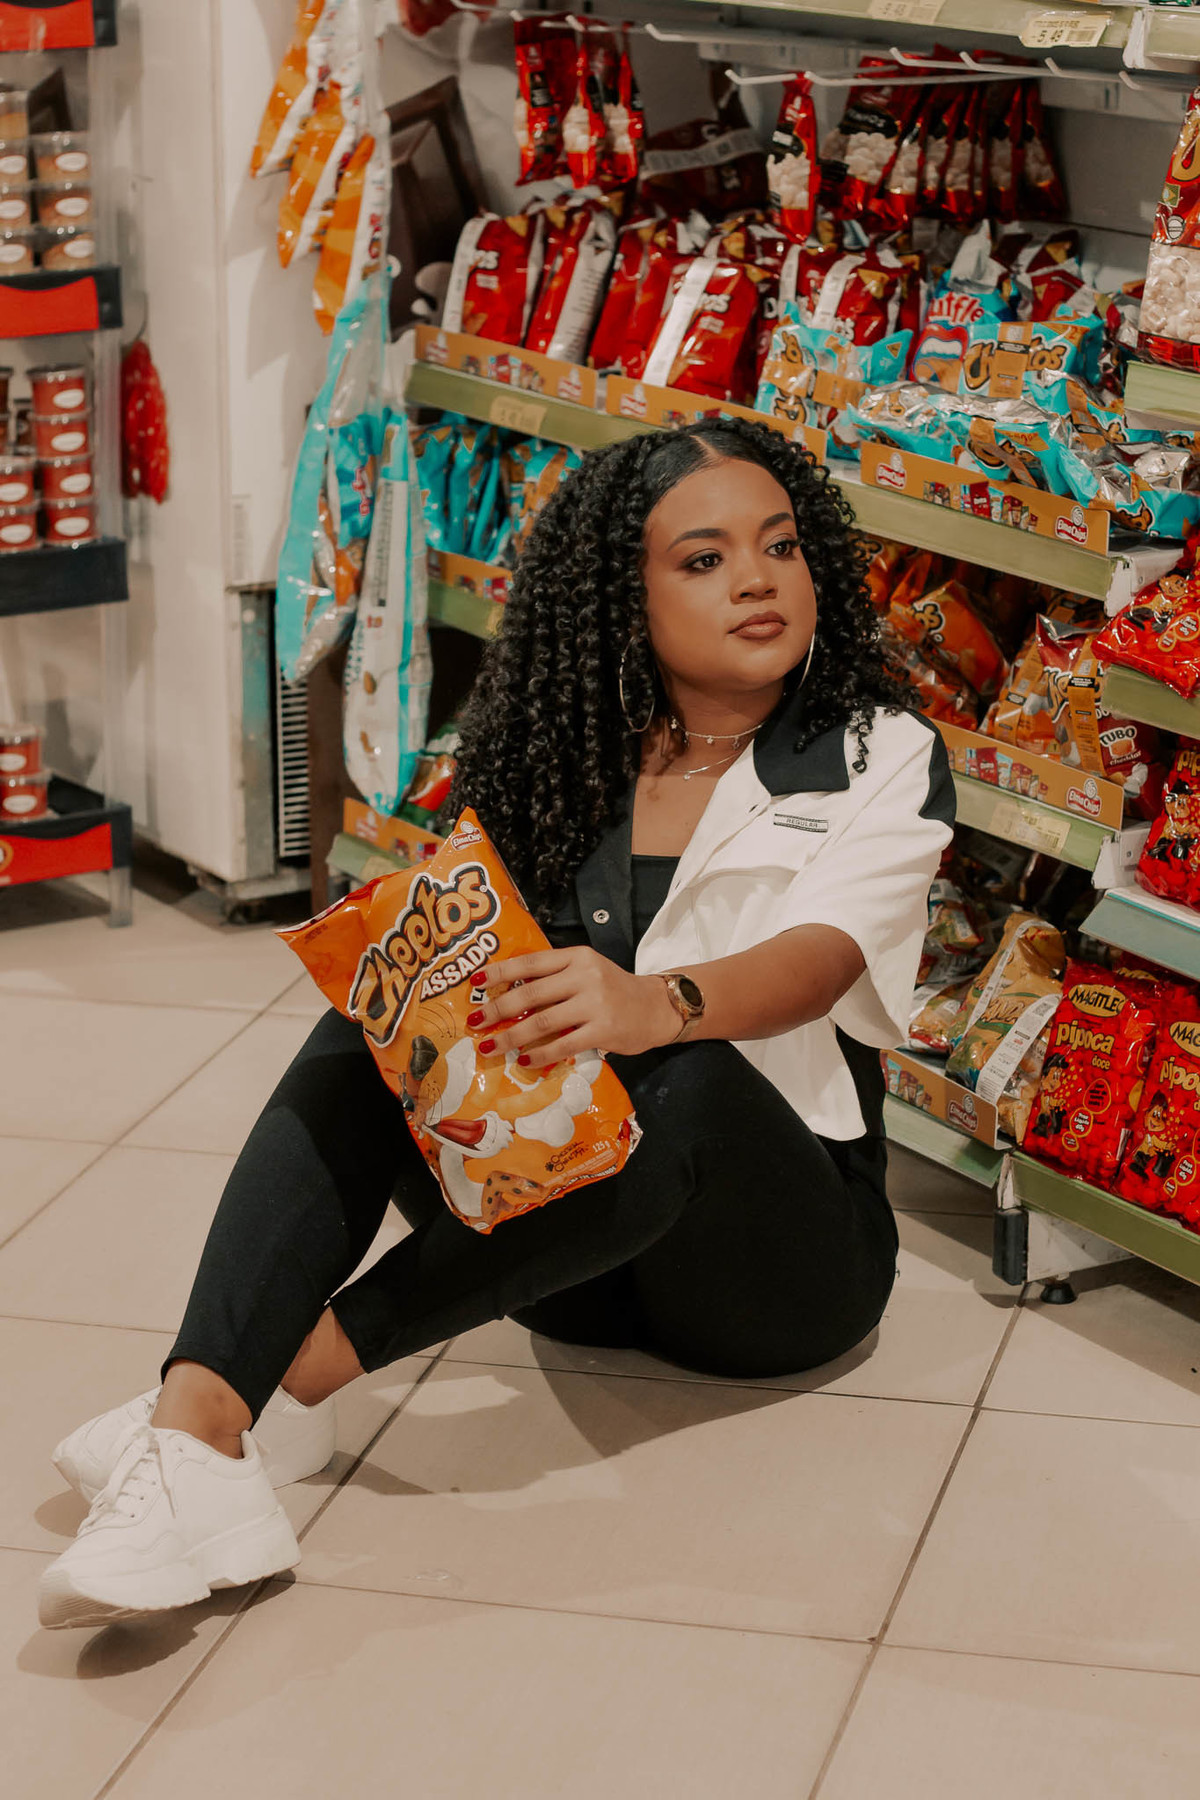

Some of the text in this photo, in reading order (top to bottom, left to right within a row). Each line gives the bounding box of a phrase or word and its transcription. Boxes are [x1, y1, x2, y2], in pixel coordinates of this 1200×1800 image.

[928, 291, 985, 323] uffle
[963, 335, 1067, 391] Chtos
[1100, 727, 1136, 745] TUBO
[350, 865, 498, 1045] Cheetos
[420, 932, 498, 1001] ASSADO
[1055, 1020, 1116, 1056] pipoca
[1091, 1054, 1111, 1071] doce
[592, 1141, 605, 1153] 125
